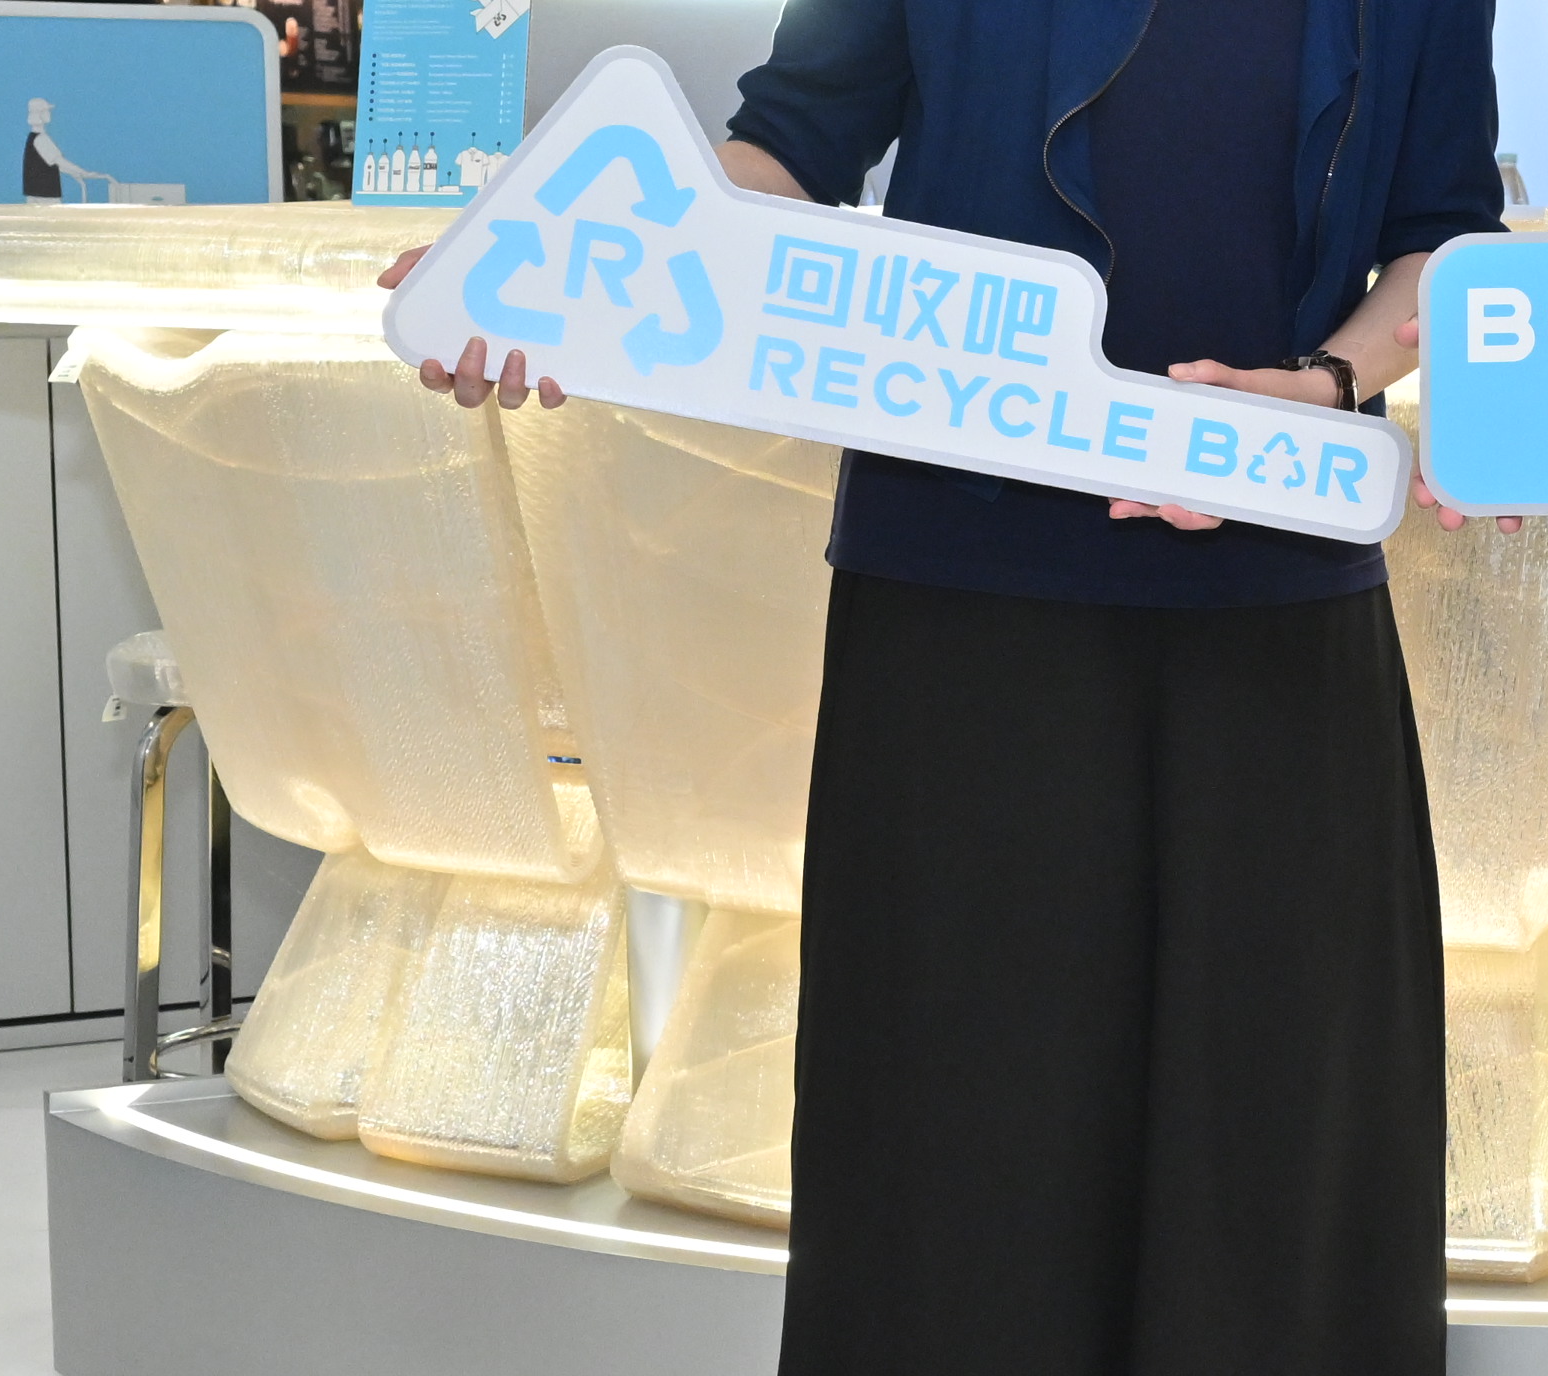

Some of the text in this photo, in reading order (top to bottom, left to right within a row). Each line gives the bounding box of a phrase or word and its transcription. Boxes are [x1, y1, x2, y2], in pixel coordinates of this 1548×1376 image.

[563, 218, 646, 309] R
[762, 233, 1058, 366] 回收吧
[748, 335, 1155, 464] RECYCLE
